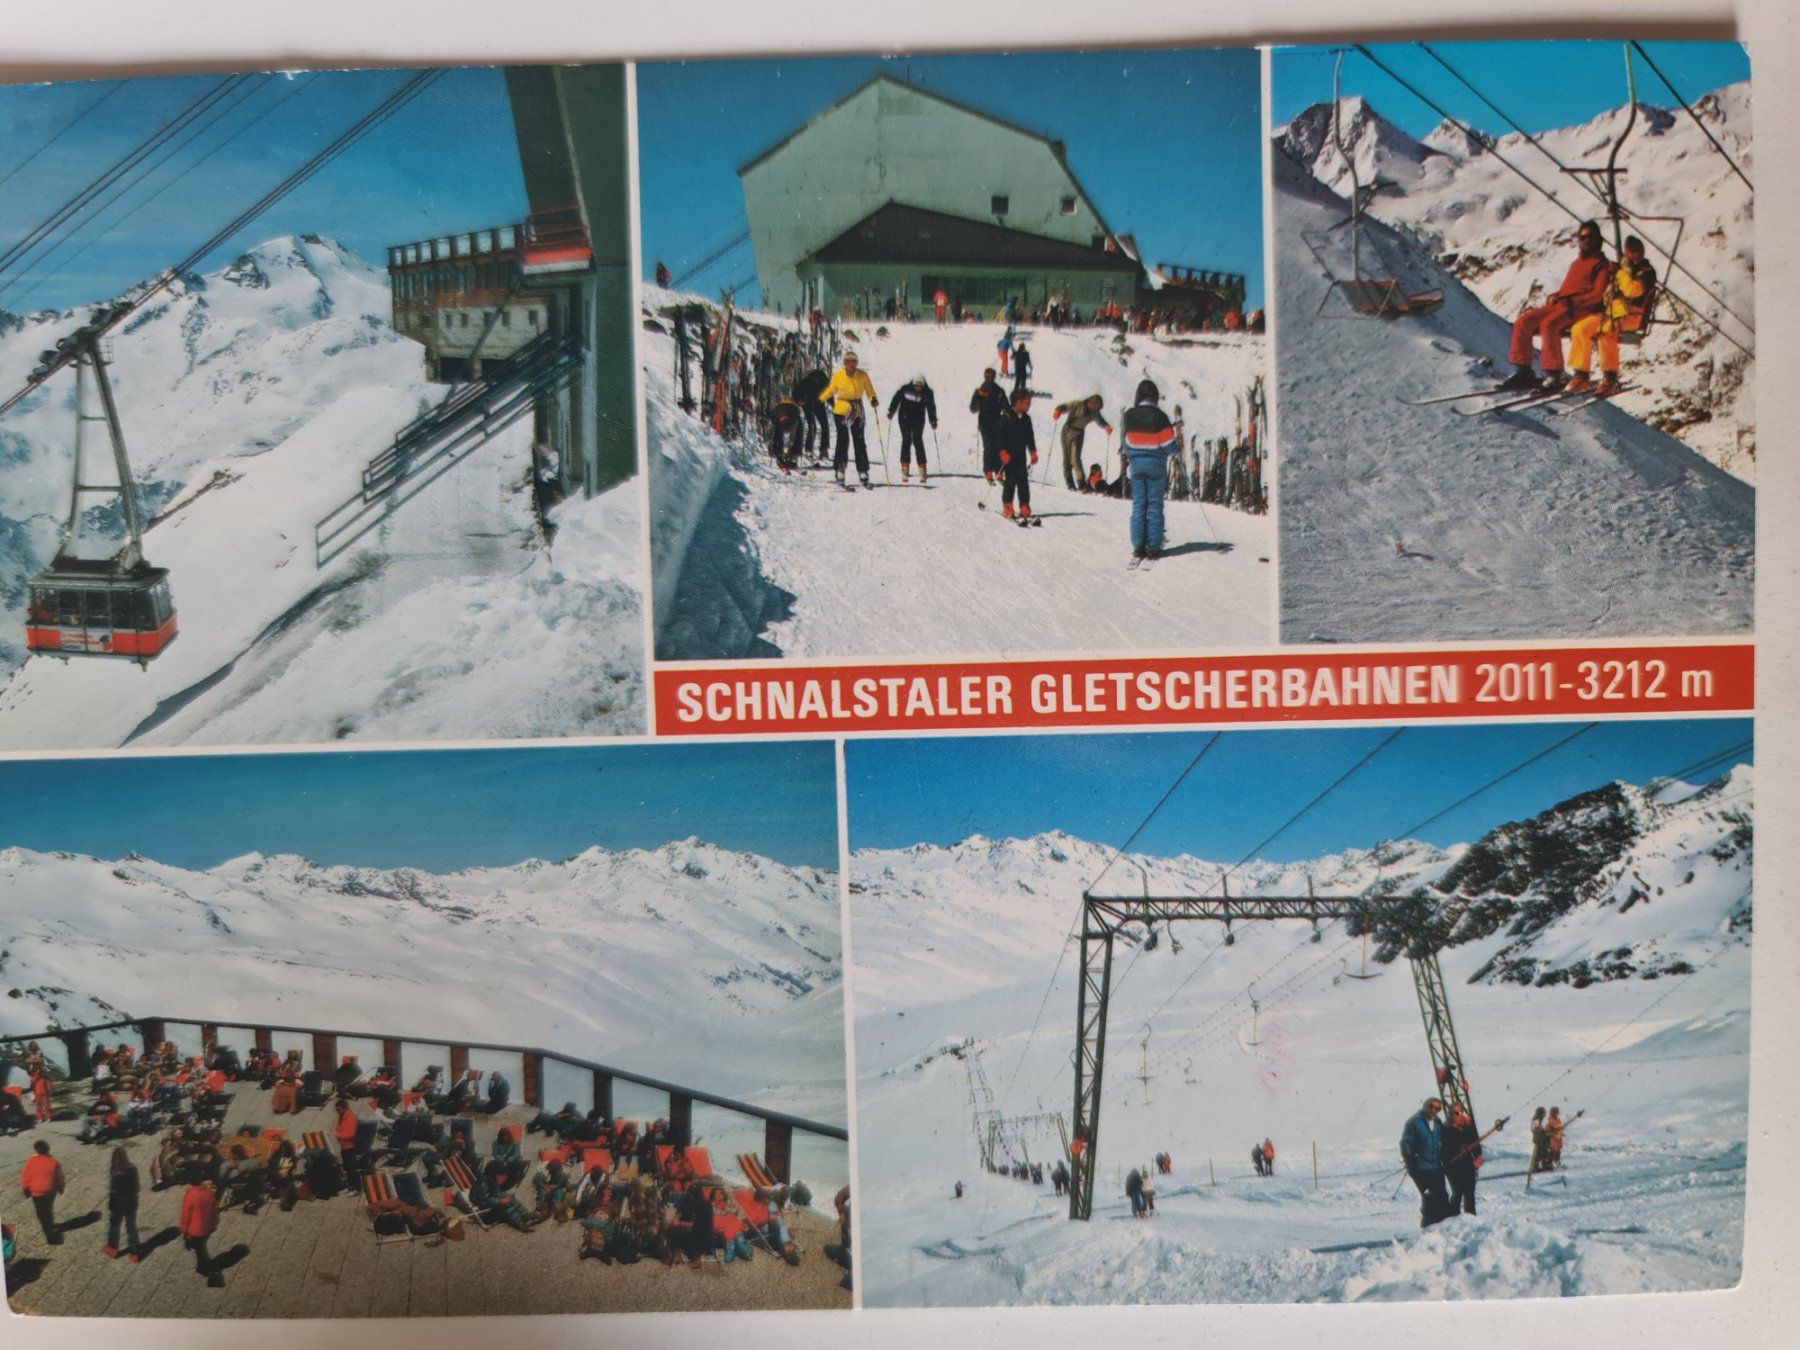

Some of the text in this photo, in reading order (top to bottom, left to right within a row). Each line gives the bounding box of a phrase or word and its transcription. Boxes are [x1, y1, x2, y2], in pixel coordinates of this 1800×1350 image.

[677, 660, 1713, 722] SCHNALSTALER GLETSCHERBAHNEN 2011-3212 m
